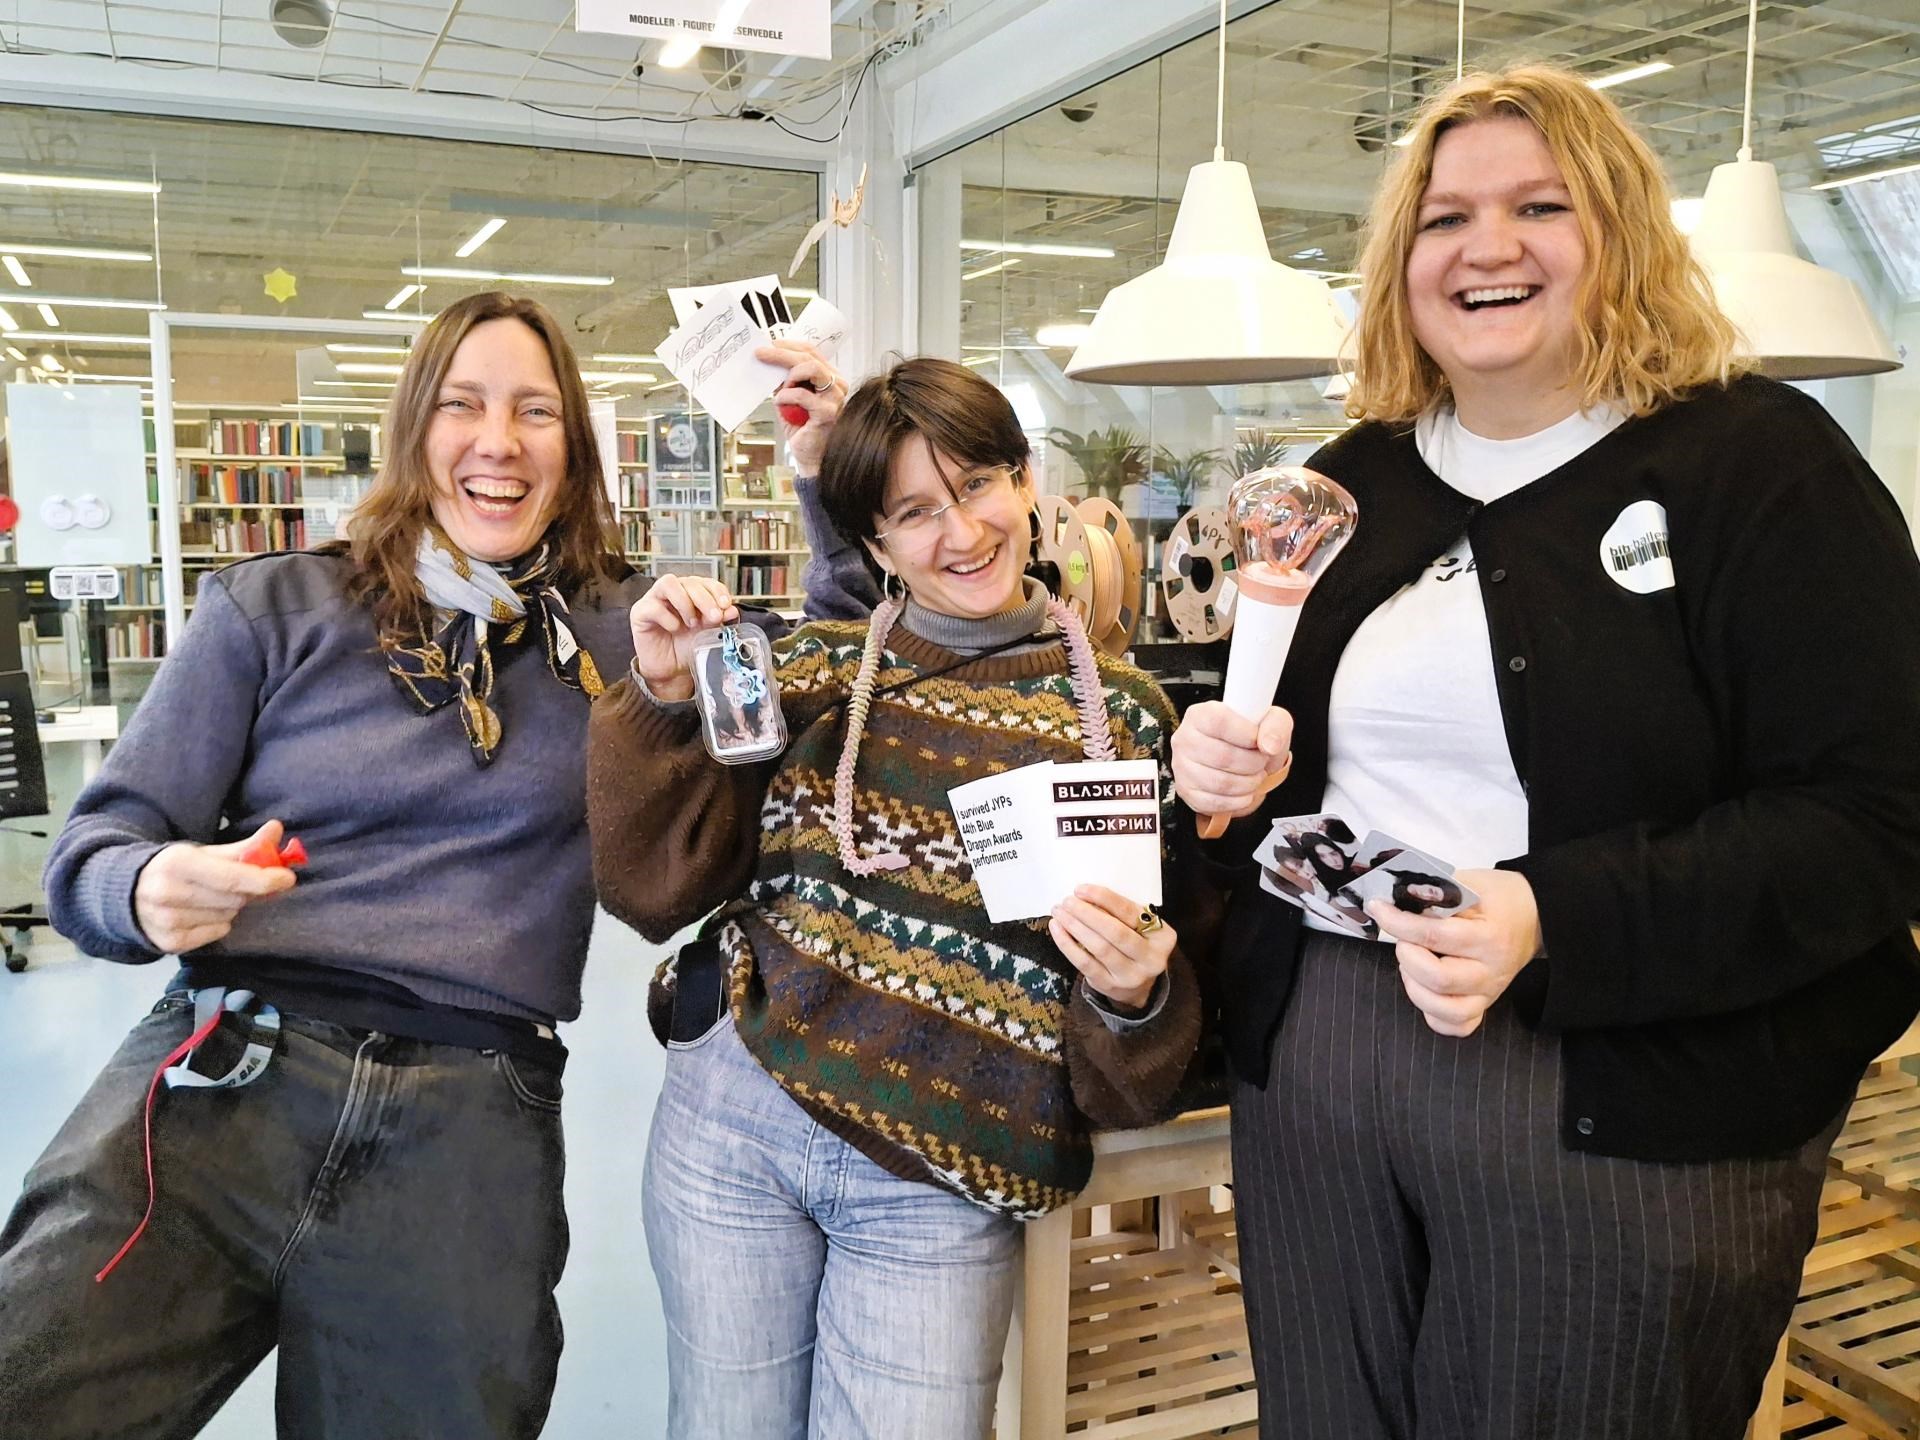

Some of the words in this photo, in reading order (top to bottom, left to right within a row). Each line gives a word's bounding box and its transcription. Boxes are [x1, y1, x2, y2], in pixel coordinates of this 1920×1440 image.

[629, 14, 675, 28] MODELLER
[683, 19, 717, 32] FIGURE
[731, 25, 783, 40] SERVEDELE
[769, 326, 792, 341] BT
[1058, 783, 1151, 799] BLACKPINK
[960, 800, 990, 820] survived
[991, 795, 1013, 811] JYPs
[962, 822, 977, 835] 44th
[976, 819, 995, 833] Blue
[1062, 817, 1153, 833] BLACKPINK
[966, 838, 993, 852] Dragon
[992, 828, 1023, 846] Awards
[972, 849, 1018, 869] performance
